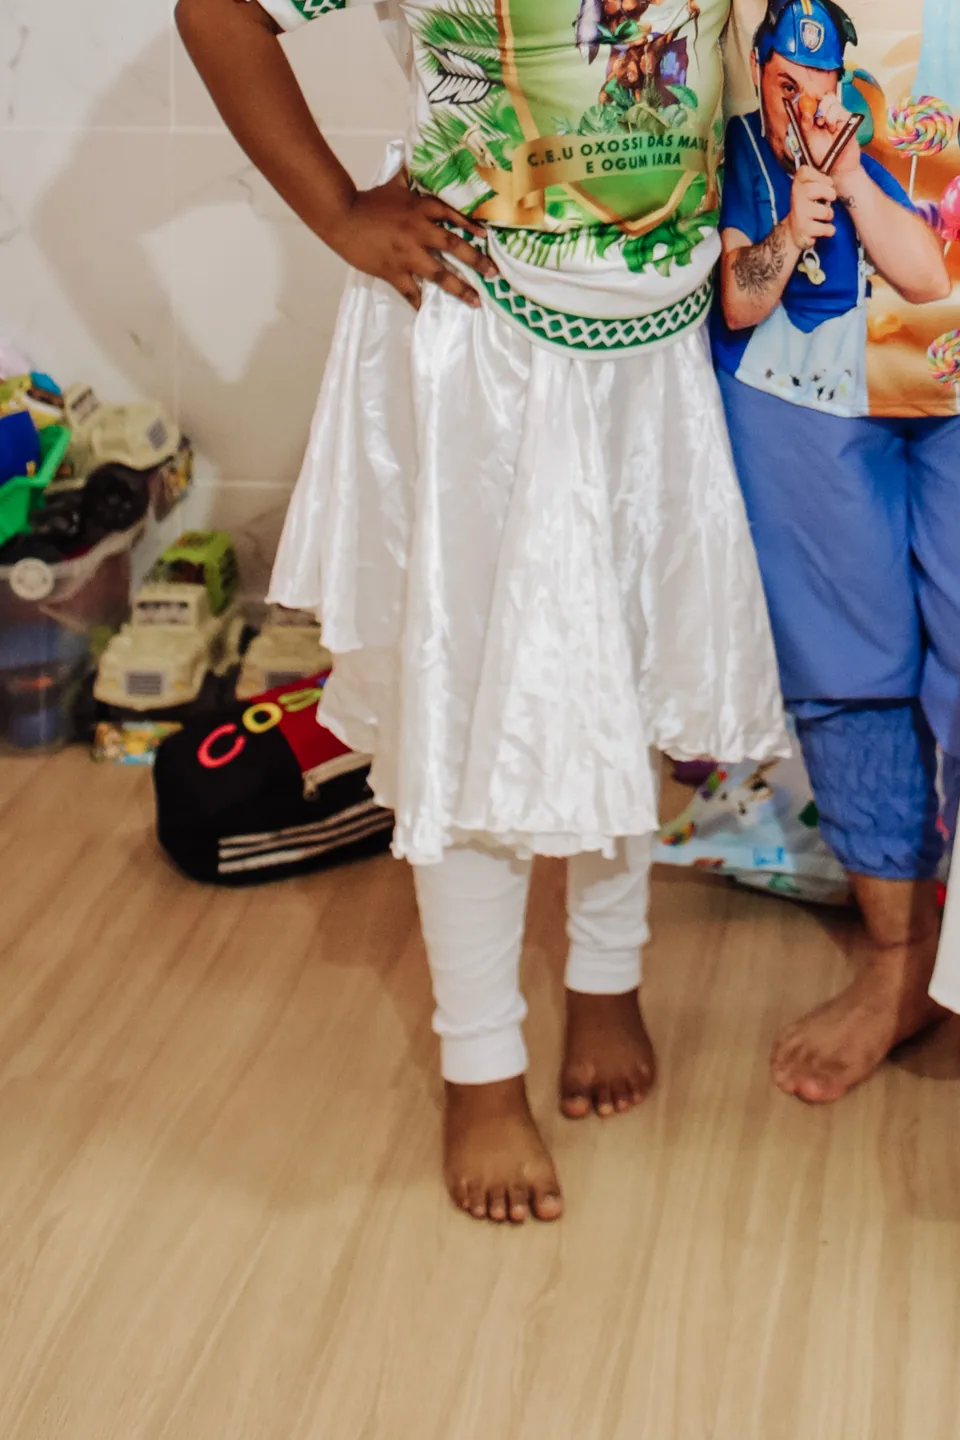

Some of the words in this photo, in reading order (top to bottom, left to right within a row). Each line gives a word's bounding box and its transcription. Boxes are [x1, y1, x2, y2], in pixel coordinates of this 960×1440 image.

[526, 146, 573, 167] C.E.U
[580, 136, 643, 156] OXOSSI
[647, 134, 673, 148] DAS
[586, 161, 594, 174] E
[601, 154, 648, 172] OGUM
[652, 152, 681, 166] IARA
